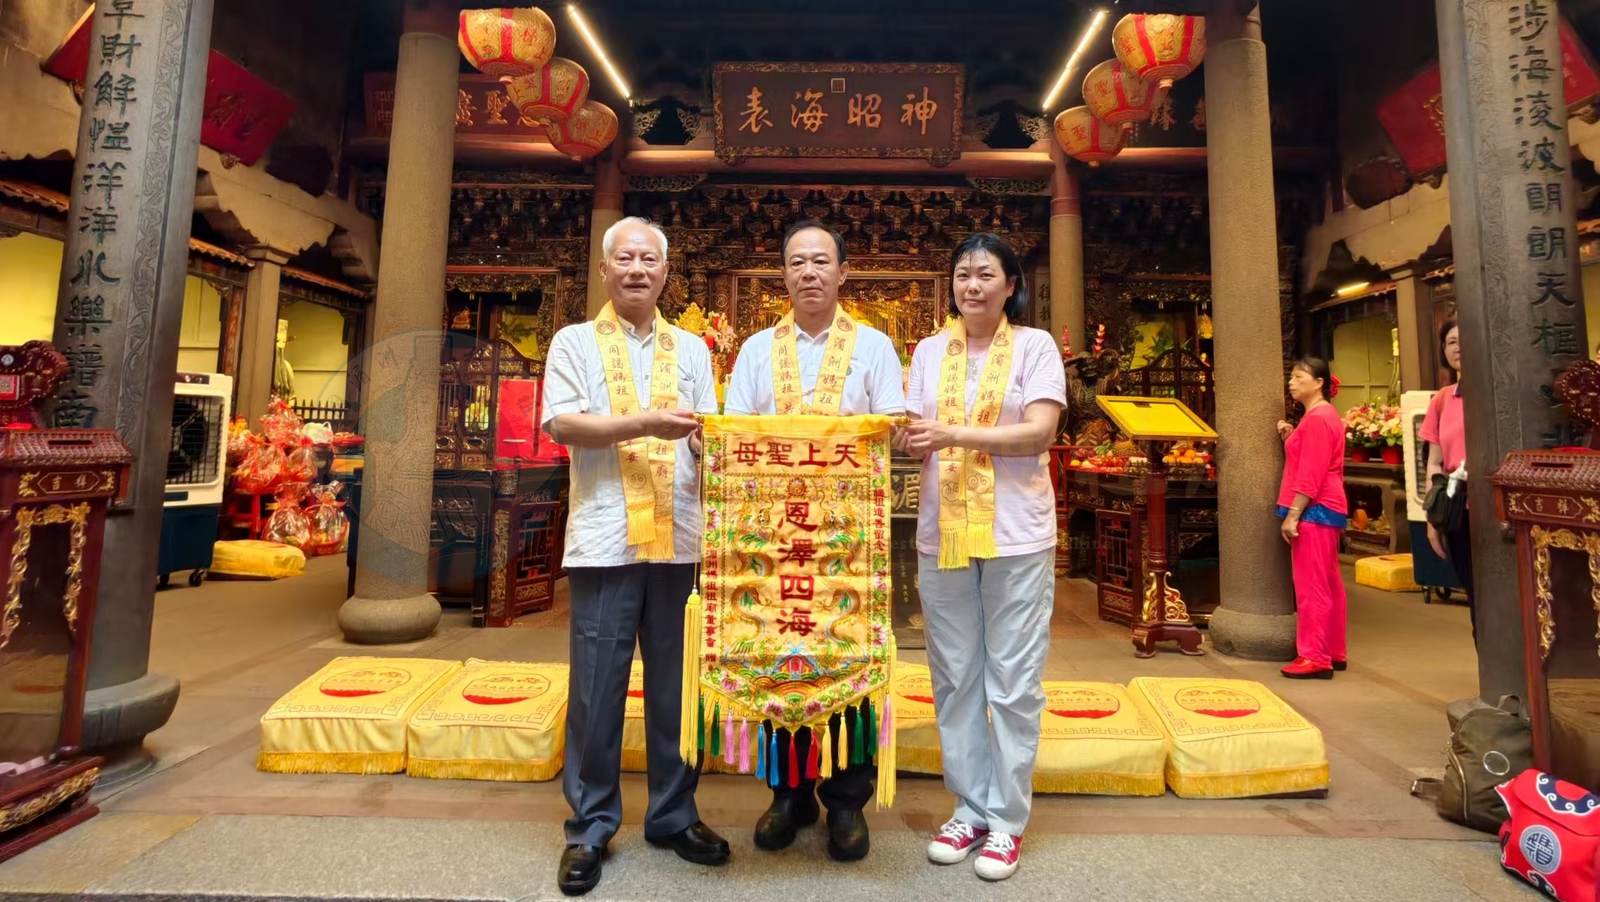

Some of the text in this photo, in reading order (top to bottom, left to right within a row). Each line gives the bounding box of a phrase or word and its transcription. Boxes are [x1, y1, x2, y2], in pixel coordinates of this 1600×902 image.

[733, 441, 861, 469] 天上聖母
[776, 501, 818, 637] 恩澤四海
